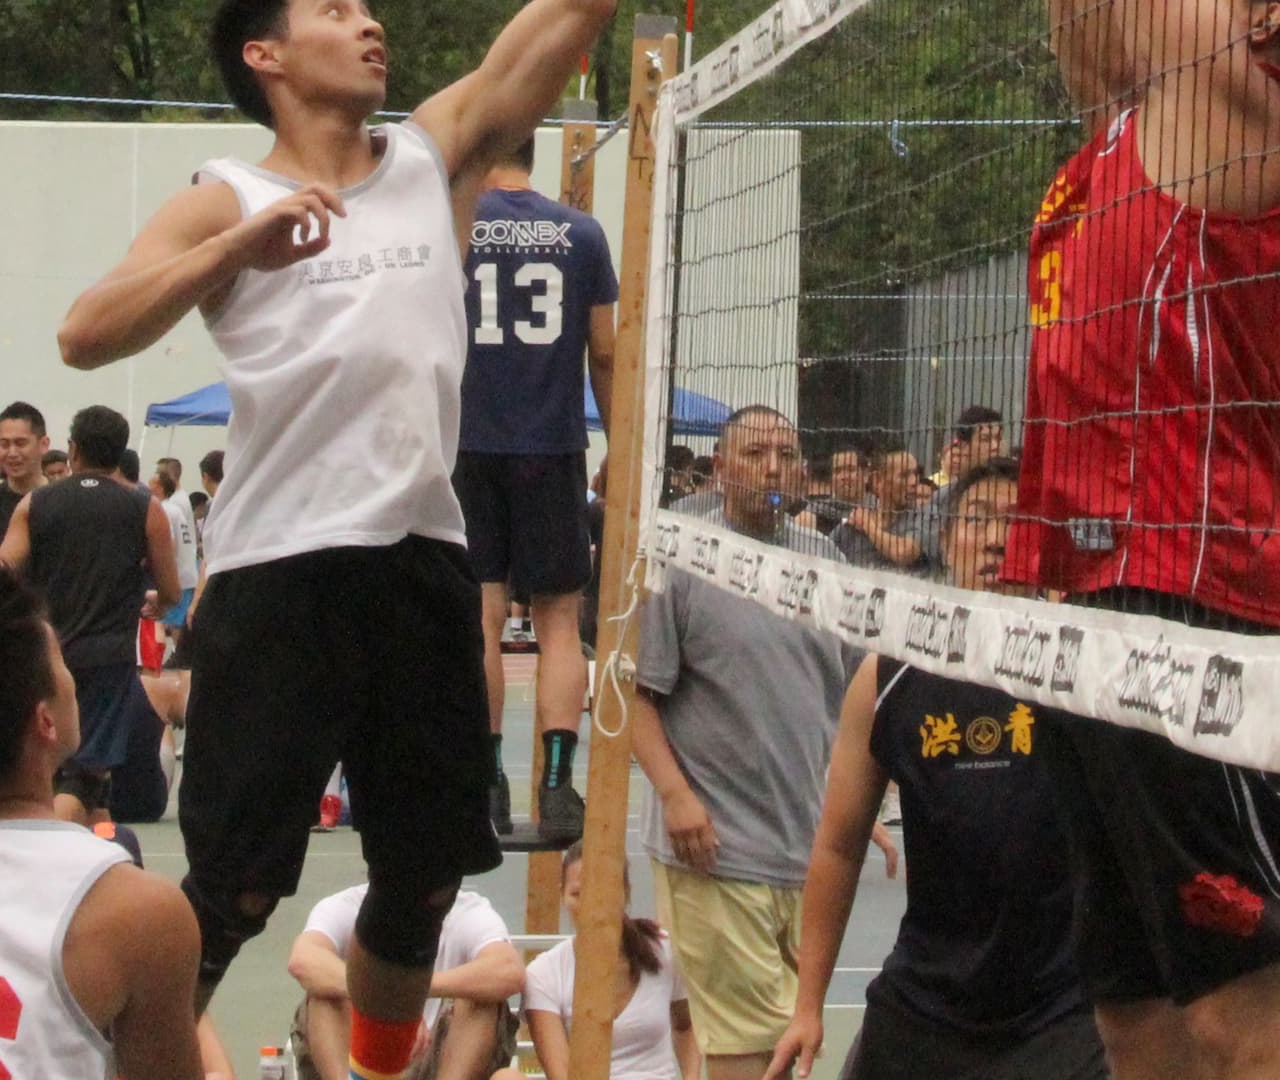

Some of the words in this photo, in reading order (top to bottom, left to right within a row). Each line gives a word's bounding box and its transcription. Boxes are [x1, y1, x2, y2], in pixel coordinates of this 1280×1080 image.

[470, 219, 573, 248] CONNEX
[473, 246, 569, 256] VOLLEYBALL
[474, 262, 563, 345] 13
